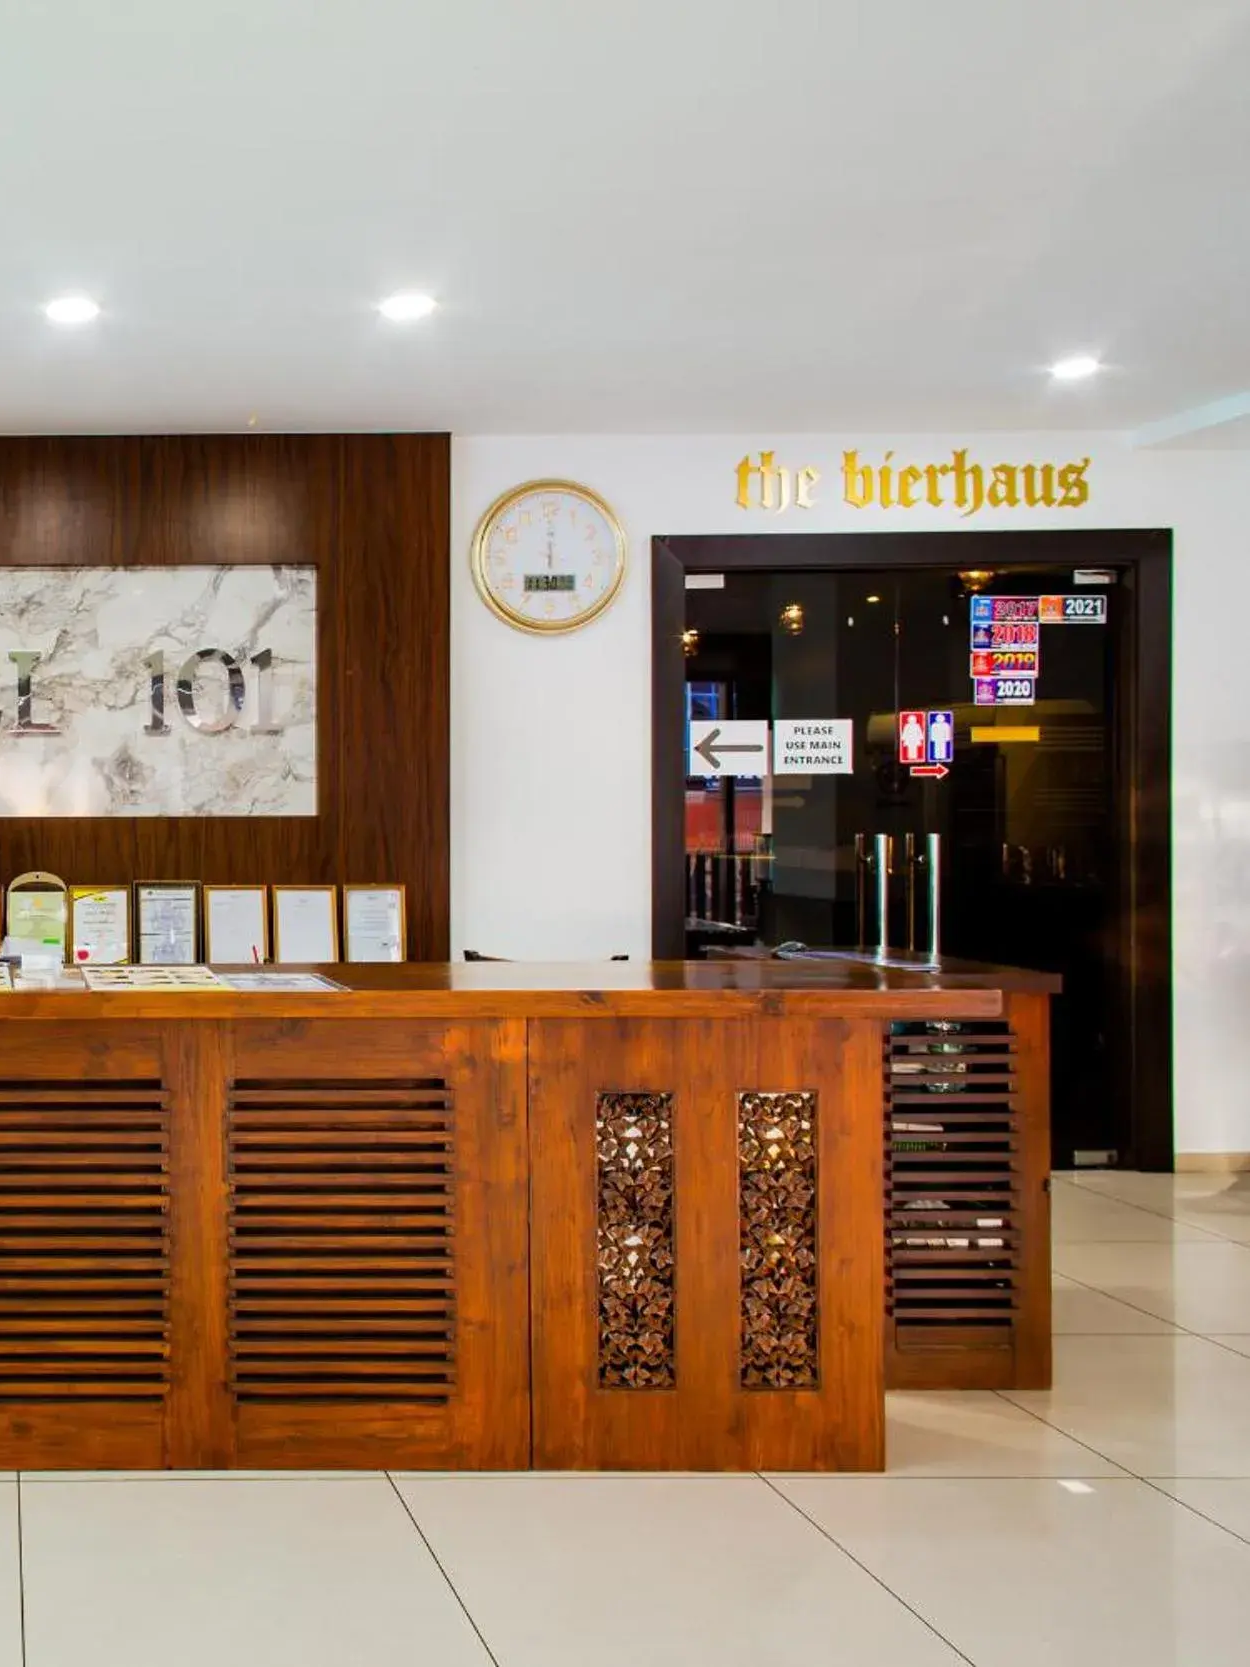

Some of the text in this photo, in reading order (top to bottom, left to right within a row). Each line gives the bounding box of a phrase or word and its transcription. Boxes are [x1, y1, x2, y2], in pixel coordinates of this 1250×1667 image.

[734, 447, 1093, 518] the bierhaus
[1065, 599, 1103, 616] 2021
[992, 623, 1036, 644] 2018
[992, 652, 1036, 671] 2019
[143, 647, 280, 737] 101
[997, 680, 1031, 697] 2020
[793, 726, 834, 736] PLEASE
[785, 741, 841, 750] USE MAIN
[784, 755, 843, 765] ENTRANCE
